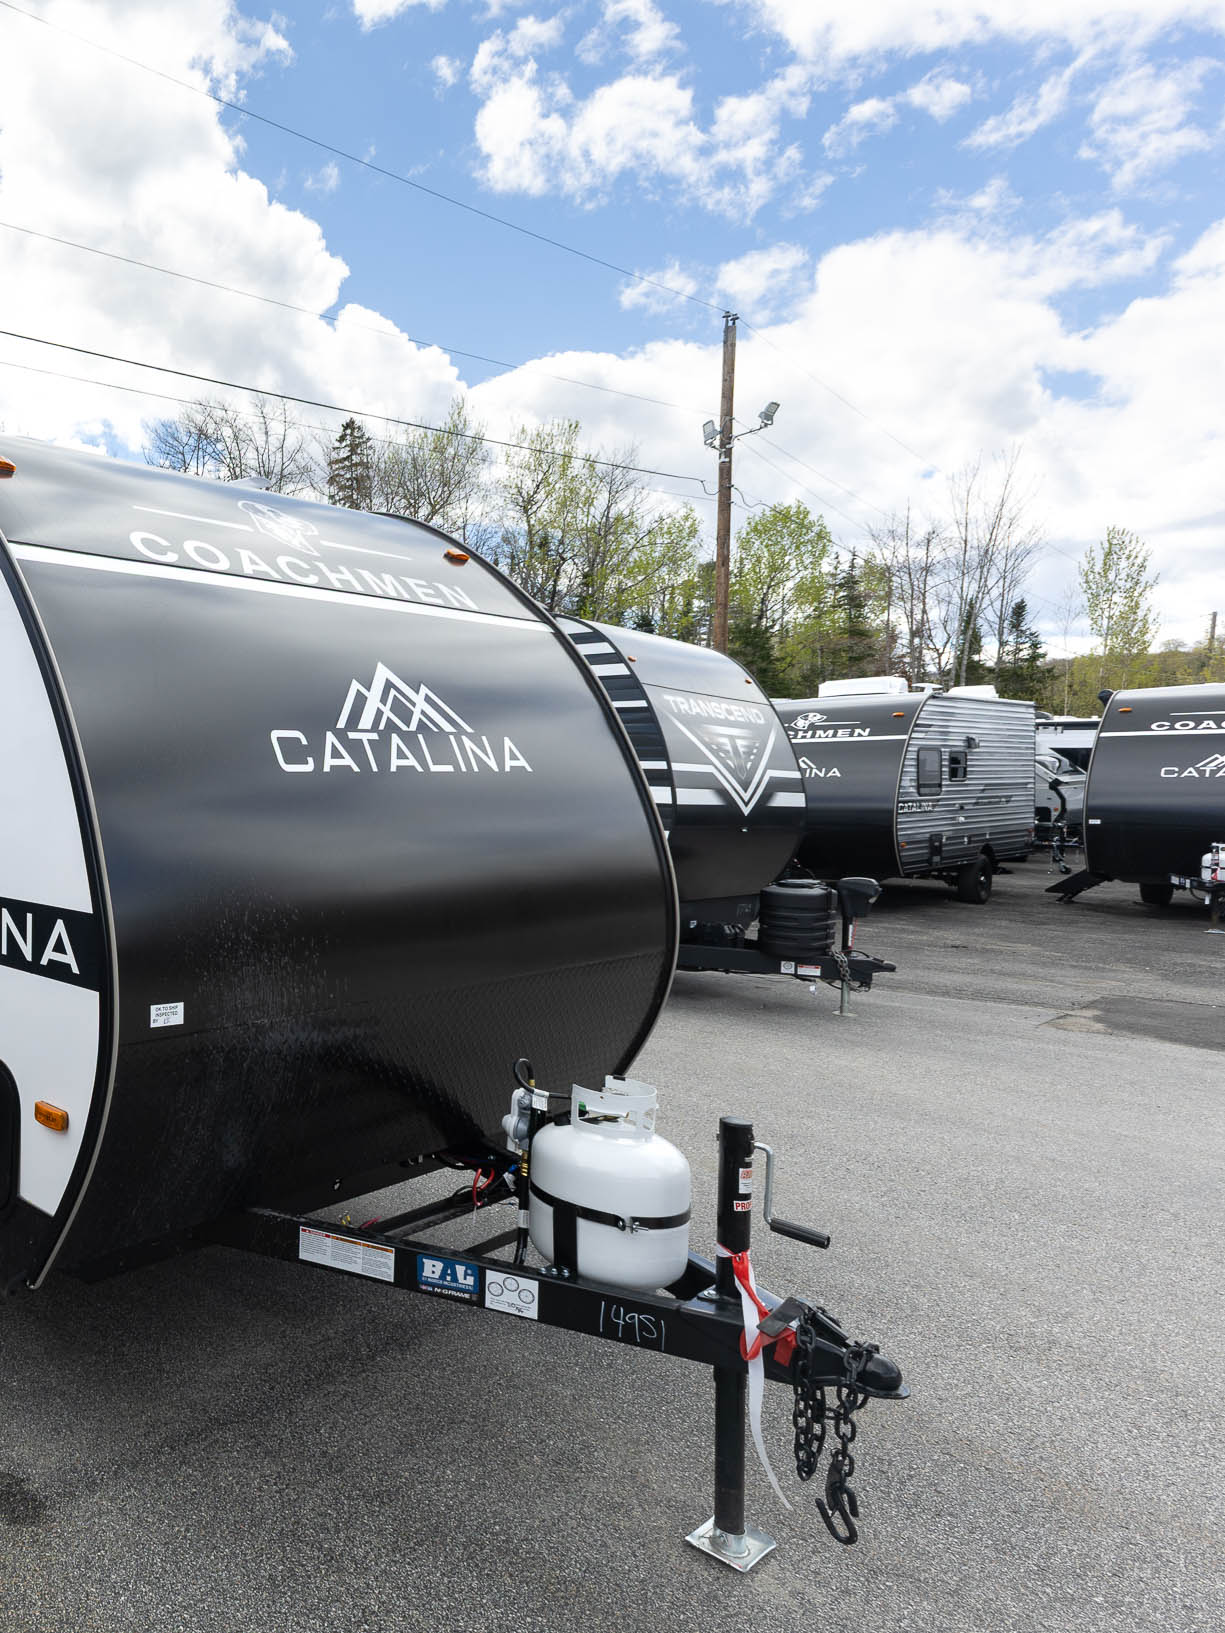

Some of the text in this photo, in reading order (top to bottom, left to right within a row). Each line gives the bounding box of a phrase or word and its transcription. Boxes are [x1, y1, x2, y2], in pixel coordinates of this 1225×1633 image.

[128, 531, 478, 609] COACHMEN
[663, 694, 766, 724] TRANSCEND
[1151, 720, 1225, 730] COA
[270, 729, 533, 772] CATALINA
[897, 802, 933, 813] CATALINA
[422, 1258, 474, 1286] BAL
